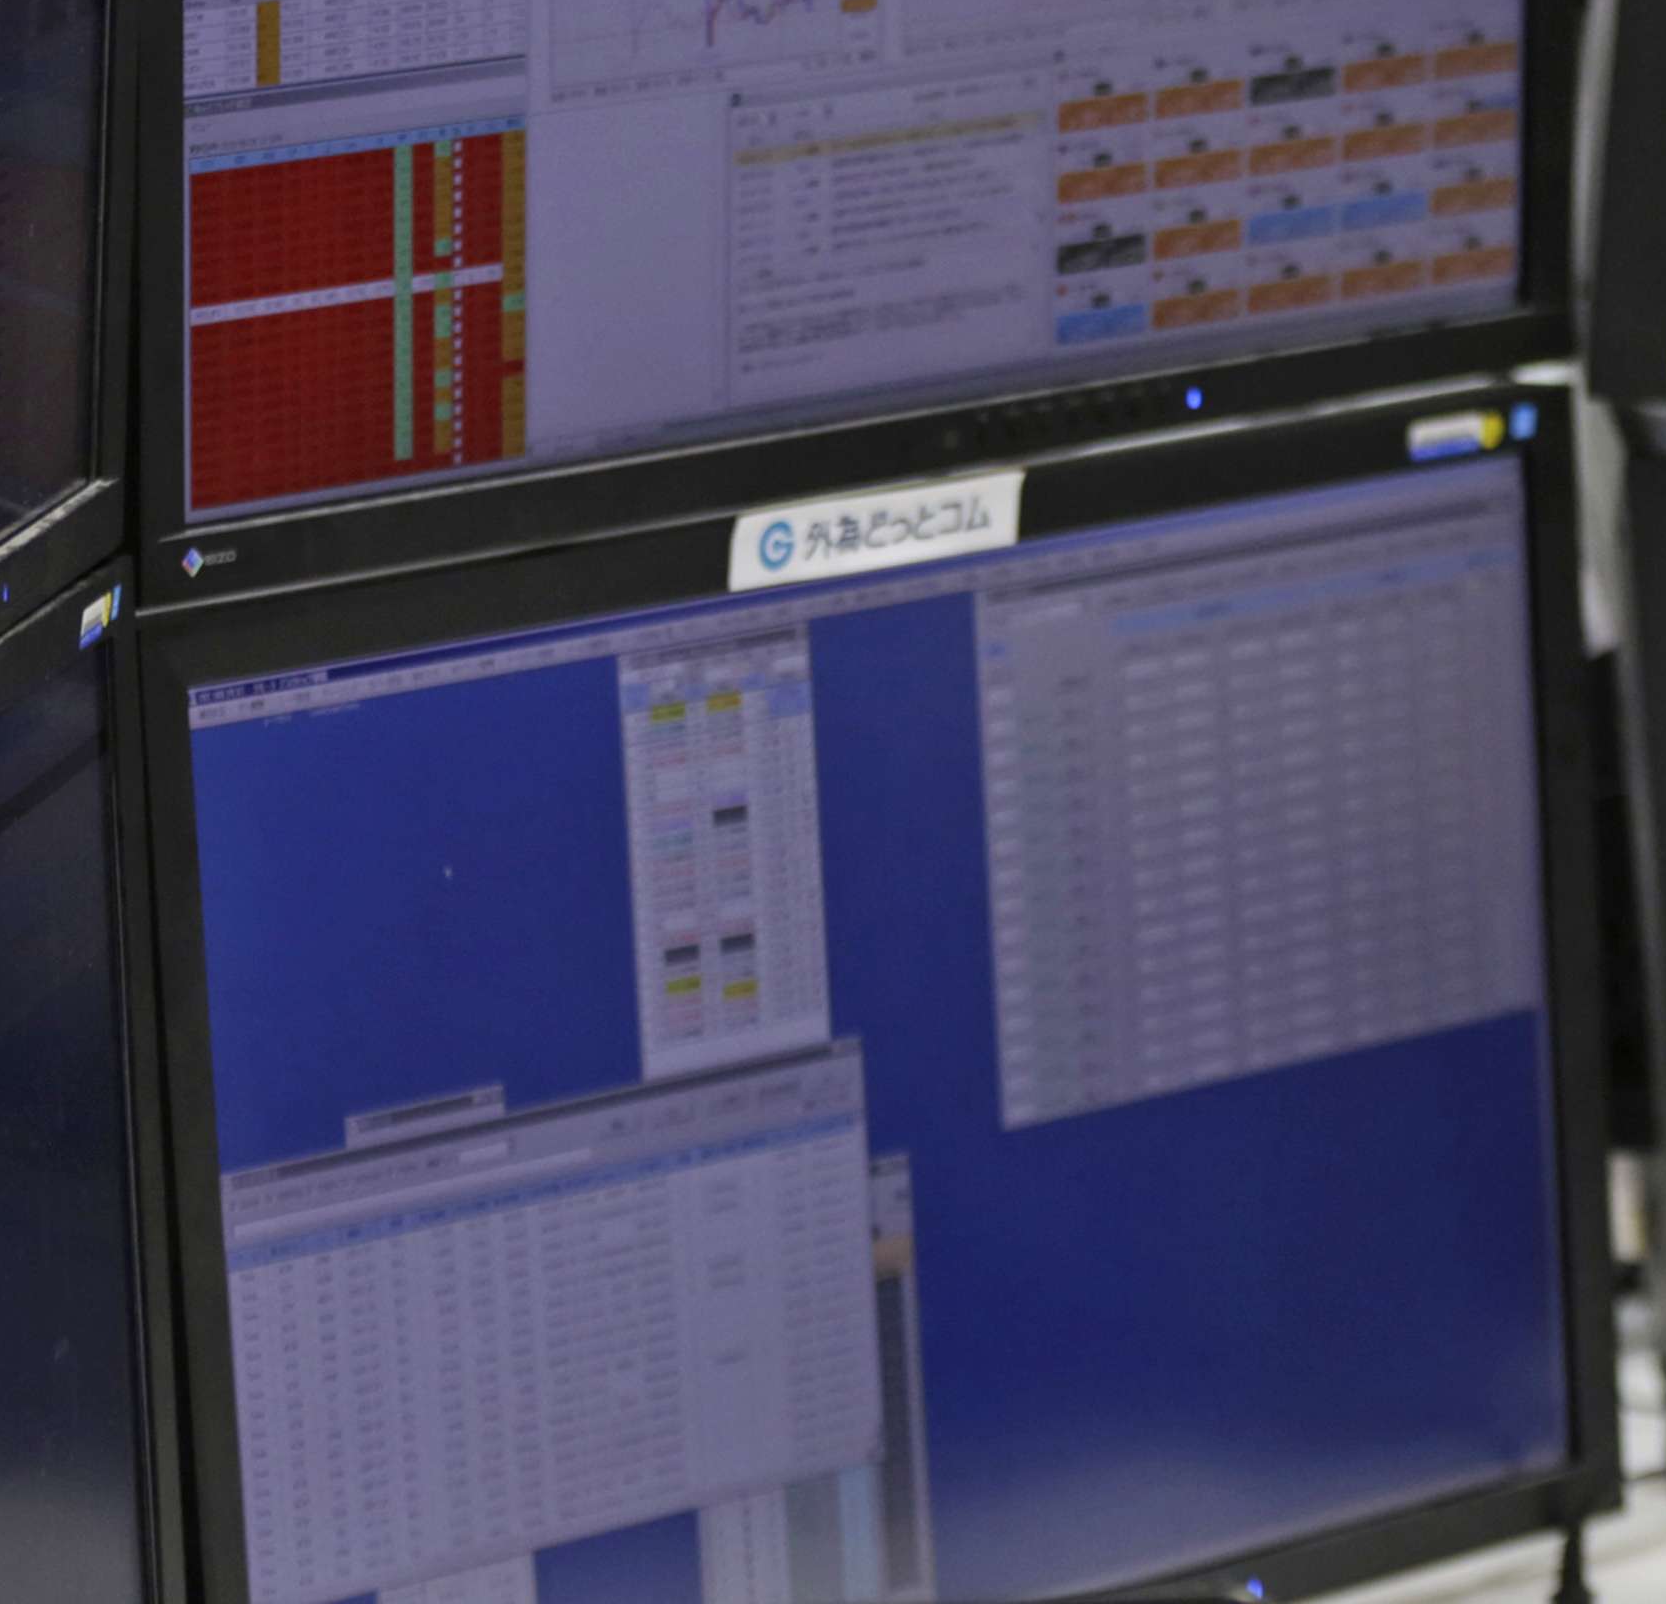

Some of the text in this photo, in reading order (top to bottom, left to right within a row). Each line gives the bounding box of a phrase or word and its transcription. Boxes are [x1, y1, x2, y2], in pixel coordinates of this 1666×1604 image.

[804, 495, 992, 561] 外為どっとコム
